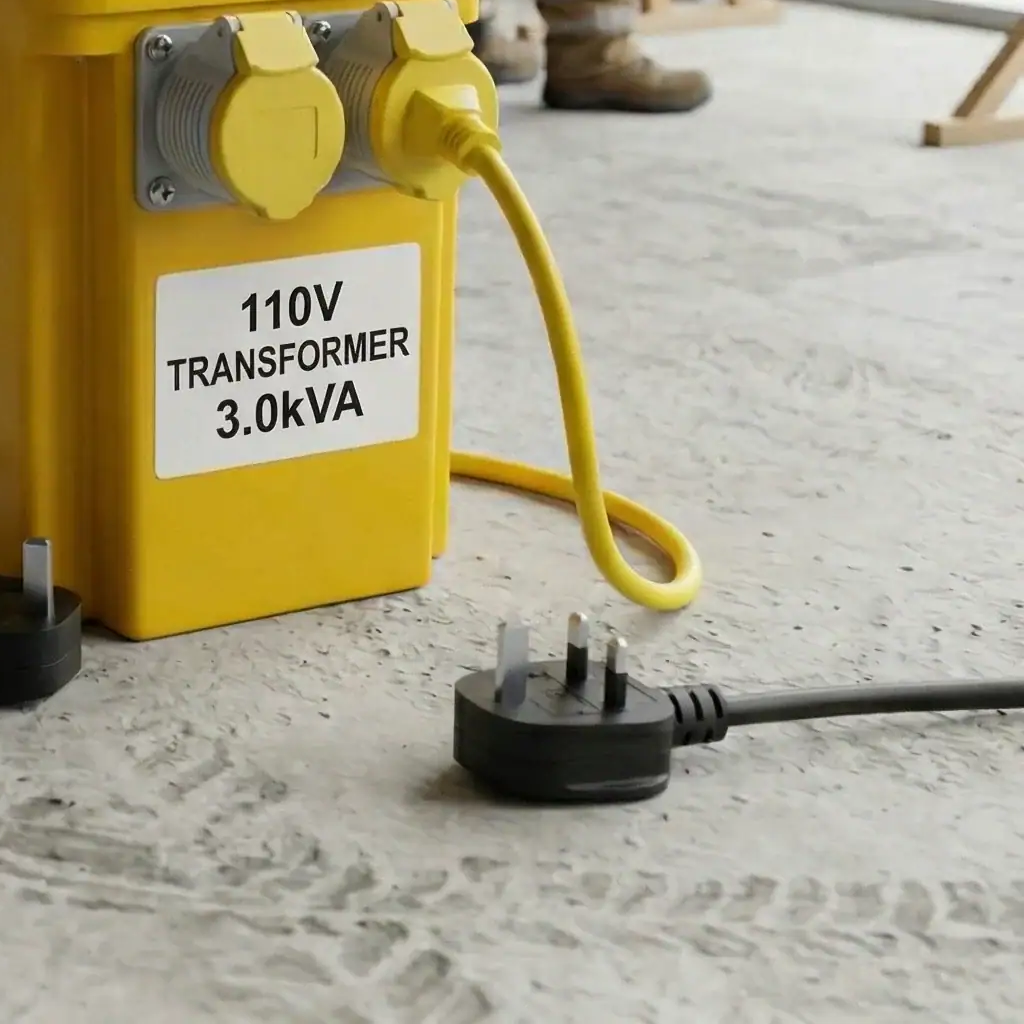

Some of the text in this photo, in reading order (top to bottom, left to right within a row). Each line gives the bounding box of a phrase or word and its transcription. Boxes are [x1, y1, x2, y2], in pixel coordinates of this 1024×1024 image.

[241, 281, 343, 332] 110V
[166, 326, 410, 391] TRANSFORMER
[216, 380, 364, 439] 3.0kVA
